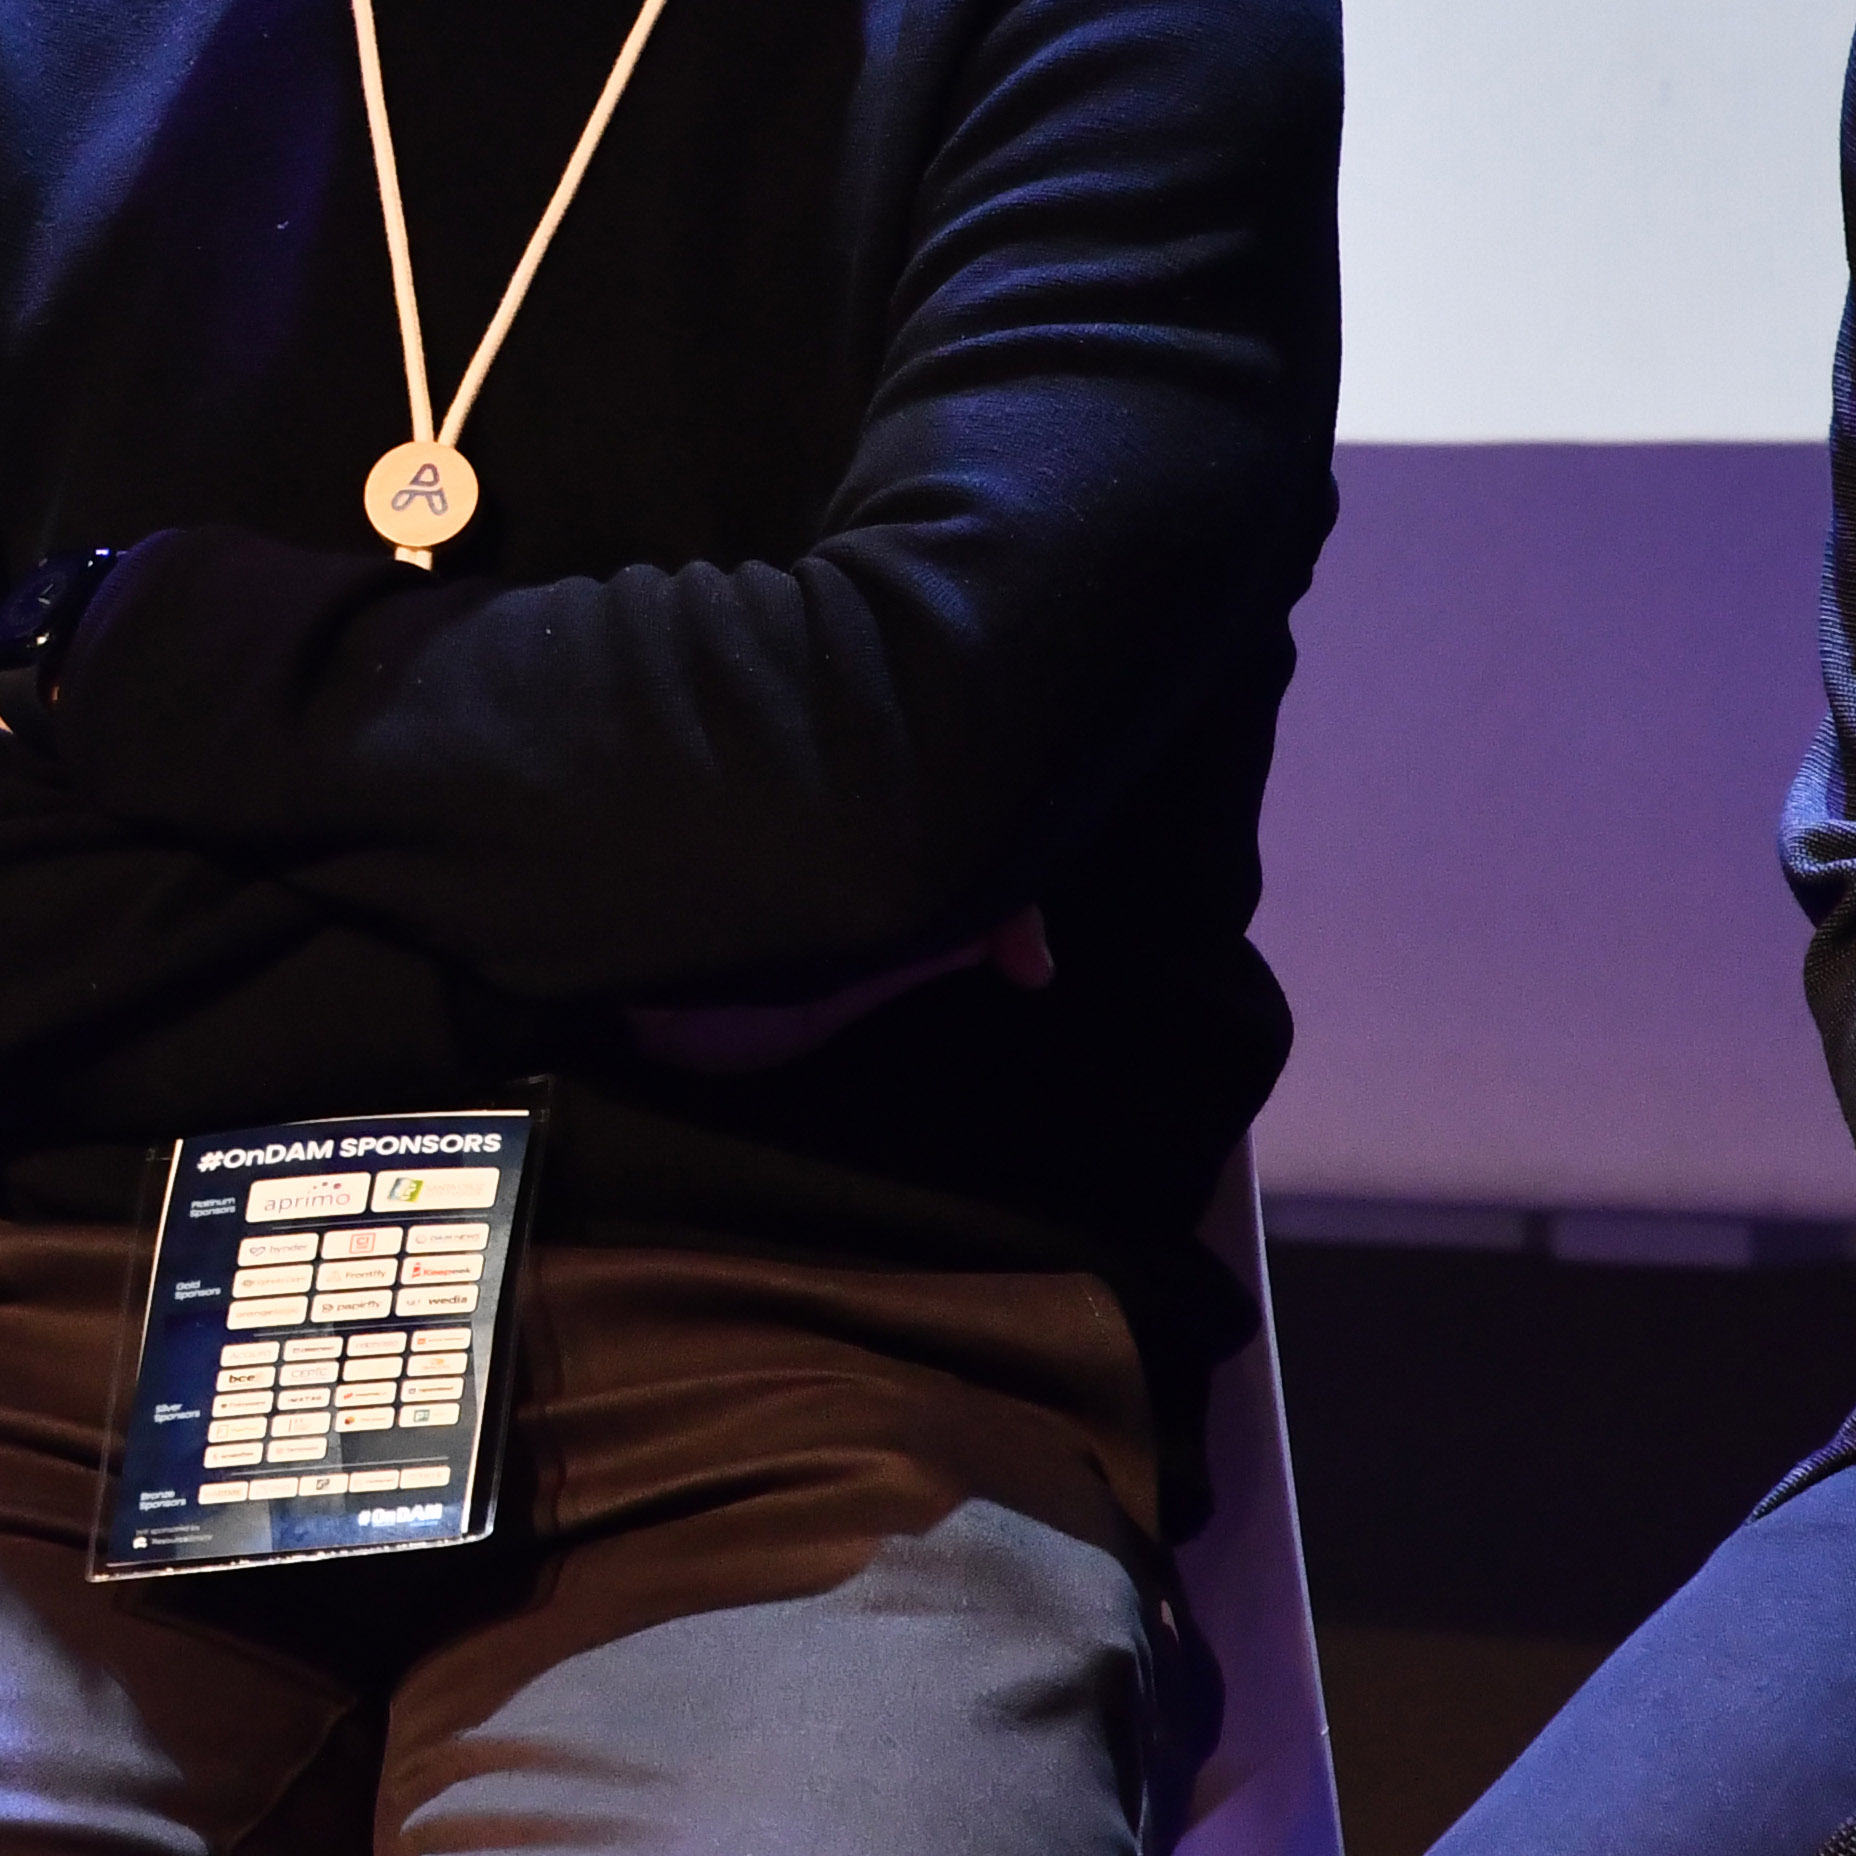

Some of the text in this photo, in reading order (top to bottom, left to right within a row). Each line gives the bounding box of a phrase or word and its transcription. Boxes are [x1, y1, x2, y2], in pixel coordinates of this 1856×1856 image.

[196, 1133, 502, 1173] #OnDAM SPONSORS
[190, 1197, 237, 1209] Platinum
[263, 1186, 351, 1214] aprimo
[189, 1205, 237, 1219] Sponsors
[175, 1280, 202, 1291] Gold
[174, 1288, 222, 1301] Sponsors
[427, 1294, 469, 1307] wedia
[155, 1403, 184, 1413] Silver
[154, 1410, 201, 1424] Sponsors
[140, 1490, 176, 1501] Bronze
[139, 1498, 187, 1511] Sponsors
